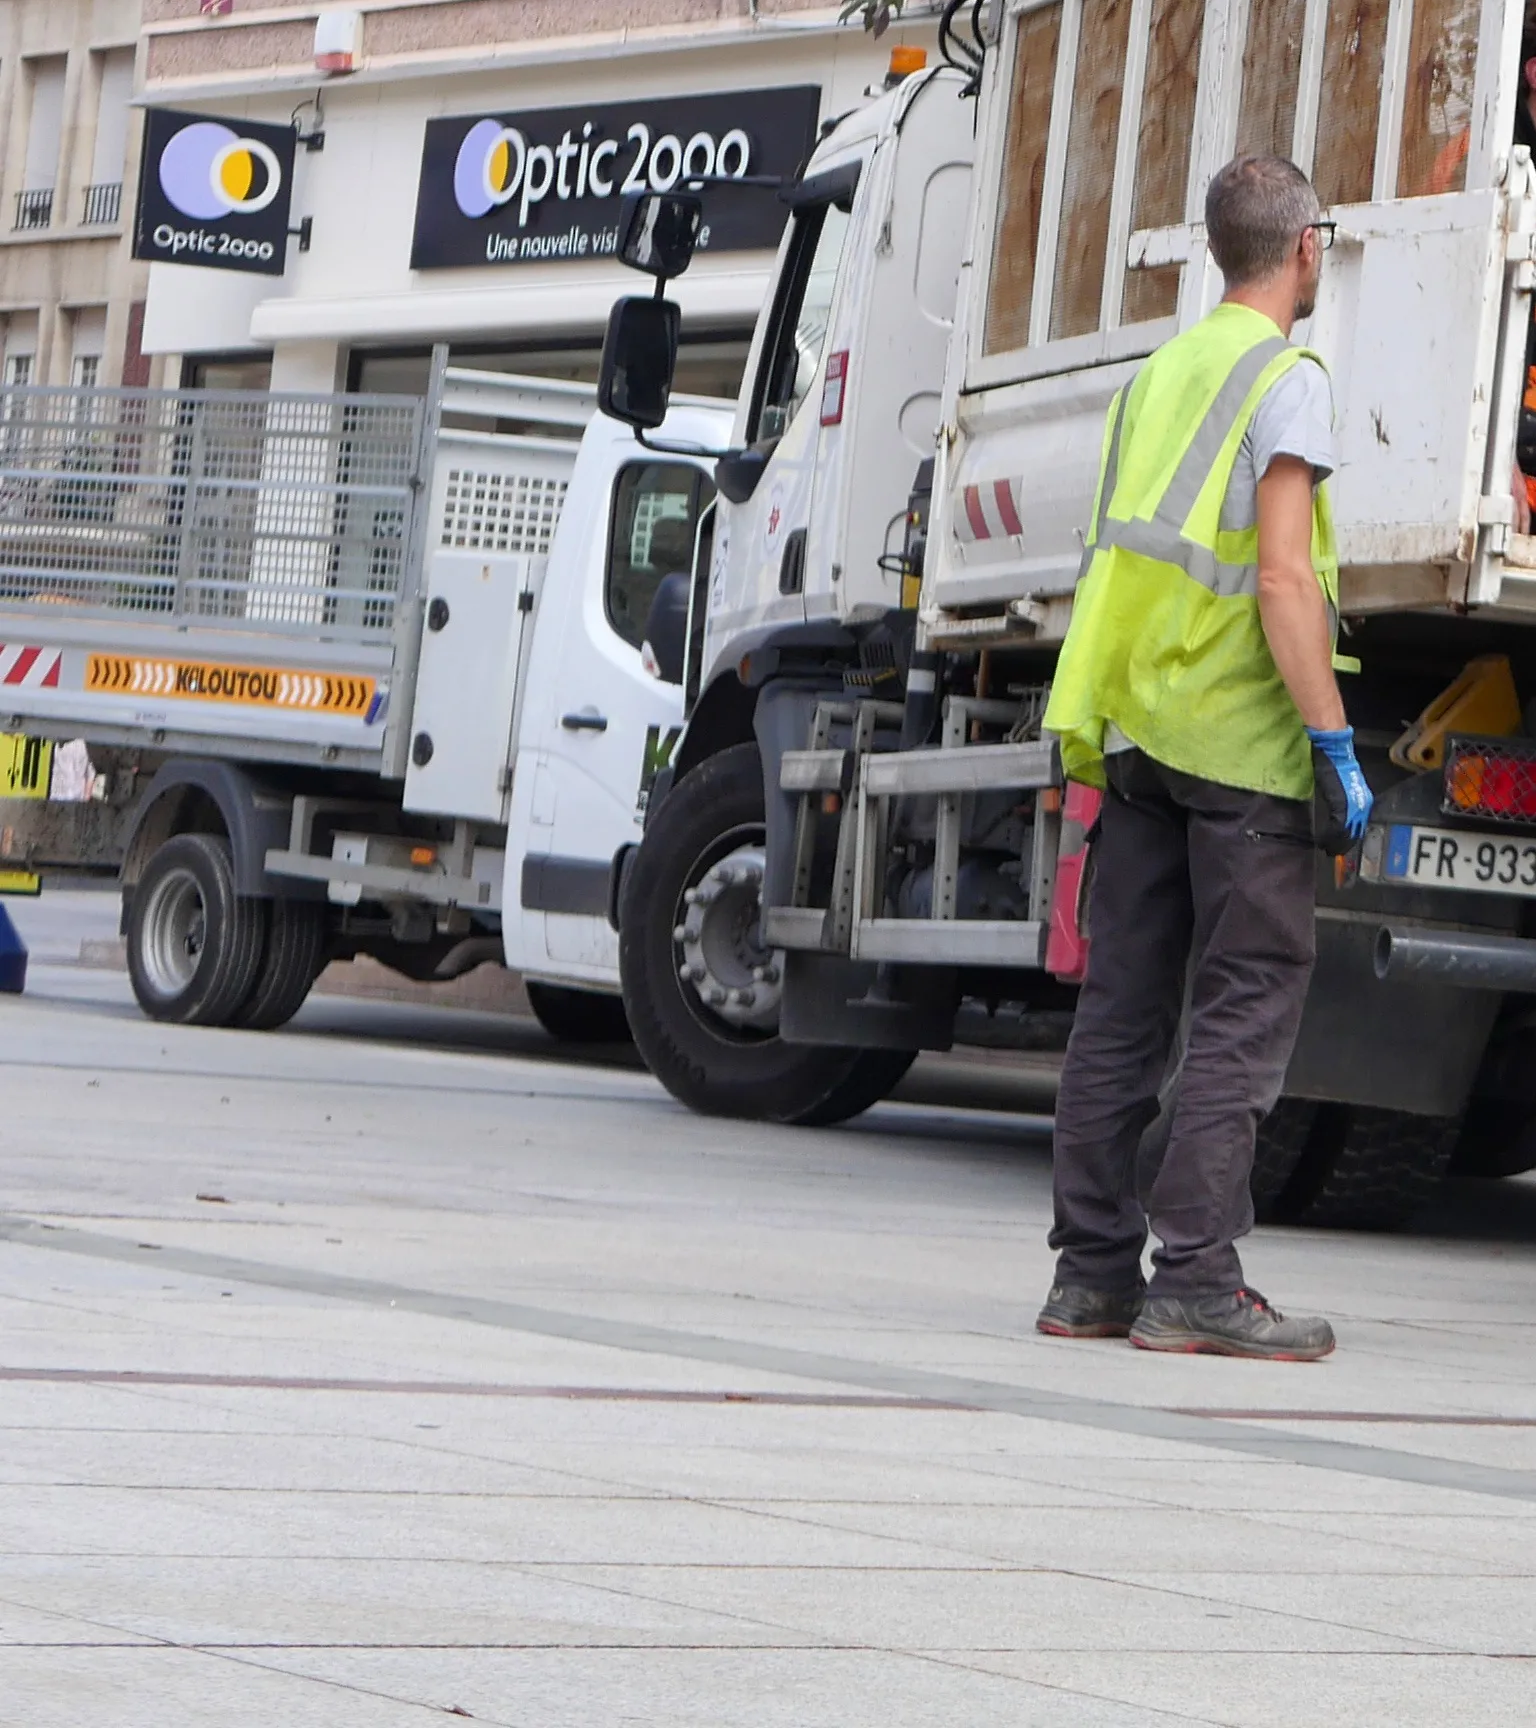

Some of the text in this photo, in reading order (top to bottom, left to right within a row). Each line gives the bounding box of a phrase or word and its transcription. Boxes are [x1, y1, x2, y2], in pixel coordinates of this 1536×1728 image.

[482, 121, 749, 227] Optic 2000
[153, 224, 274, 260] Optic 2000
[486, 225, 619, 261] Une nouvelle visi
